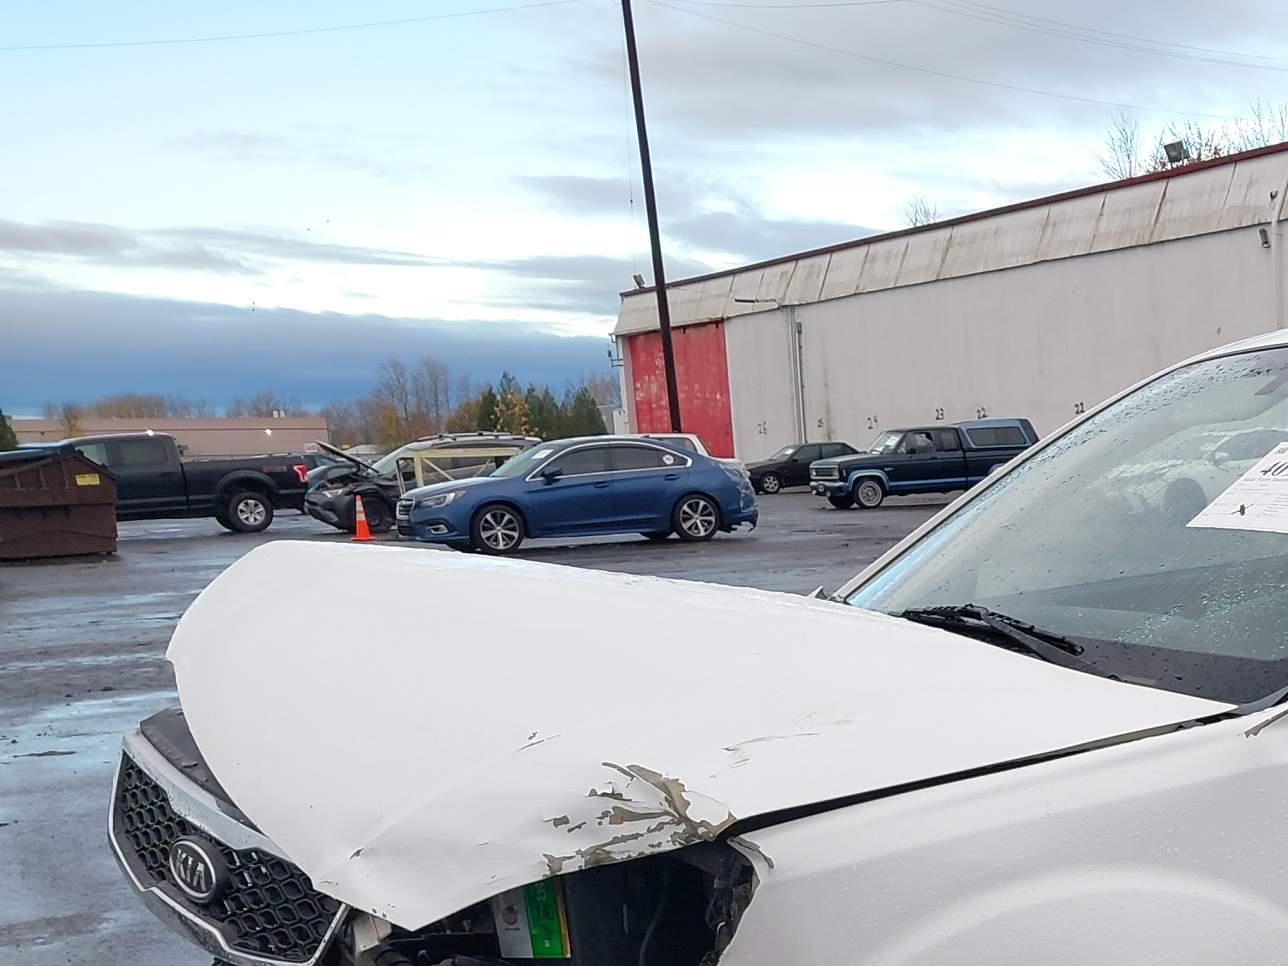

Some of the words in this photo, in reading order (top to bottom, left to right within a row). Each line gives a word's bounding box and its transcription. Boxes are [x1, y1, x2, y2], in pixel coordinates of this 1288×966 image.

[935, 408, 945, 421] 23
[976, 407, 988, 420] 22
[1074, 401, 1086, 415] 21
[175, 848, 207, 892] KIA
